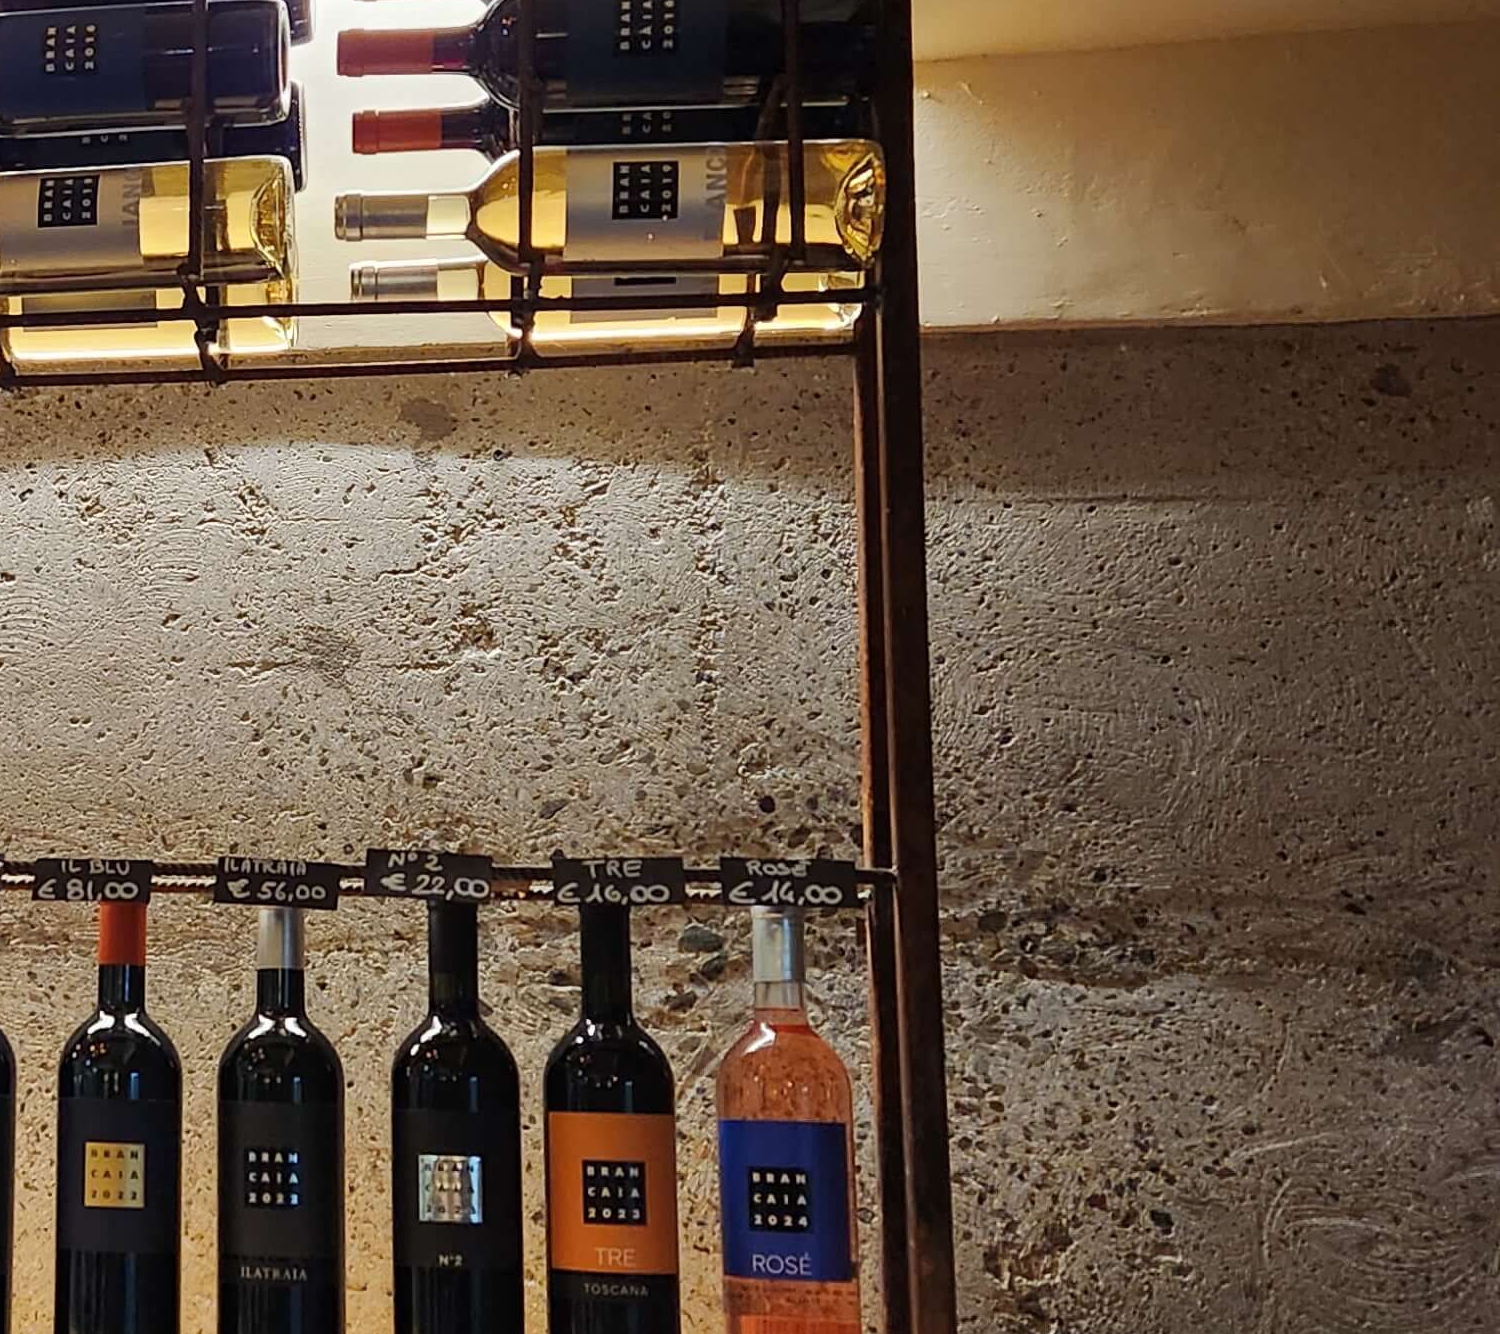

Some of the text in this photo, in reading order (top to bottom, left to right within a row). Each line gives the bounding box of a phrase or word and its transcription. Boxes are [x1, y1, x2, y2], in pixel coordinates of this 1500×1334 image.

[619, 0, 631, 51] BRAN
[45, 26, 57, 72] BRAN
[65, 25, 77, 71] CAIA
[84, 24, 96, 70] 2016
[619, 164, 631, 213] BRAN
[639, 163, 651, 213] CAIA
[660, 164, 672, 213] 2019
[43, 179, 55, 222] BRAN
[62, 177, 74, 221] CAIA
[61, 860, 131, 876] IL BLU
[223, 858, 308, 876] ILATRAIA
[581, 859, 643, 879] TRE
[38, 878, 139, 902] € 81,00
[227, 877, 327, 902] € 56,00
[380, 873, 490, 901] € 22,00
[557, 882, 670, 905] € 16,00
[729, 880, 843, 906] € 14,00
[91, 1148, 139, 1160] BRAN
[248, 1151, 299, 1164] BRAN
[91, 1169, 139, 1180] CAIA
[248, 1171, 300, 1184] CAIA
[586, 1165, 639, 1177] BRAN
[751, 1171, 806, 1185] BRAN
[587, 1185, 640, 1198] CAIA
[753, 1193, 807, 1206] CAIA
[587, 1207, 640, 1219] 2023
[753, 1212, 808, 1227] 2024
[595, 1247, 636, 1267] TRE
[752, 1251, 812, 1275] ROSÉ
[239, 1266, 308, 1281] ILATRAIA
[584, 1282, 650, 1297] TOSCANA
